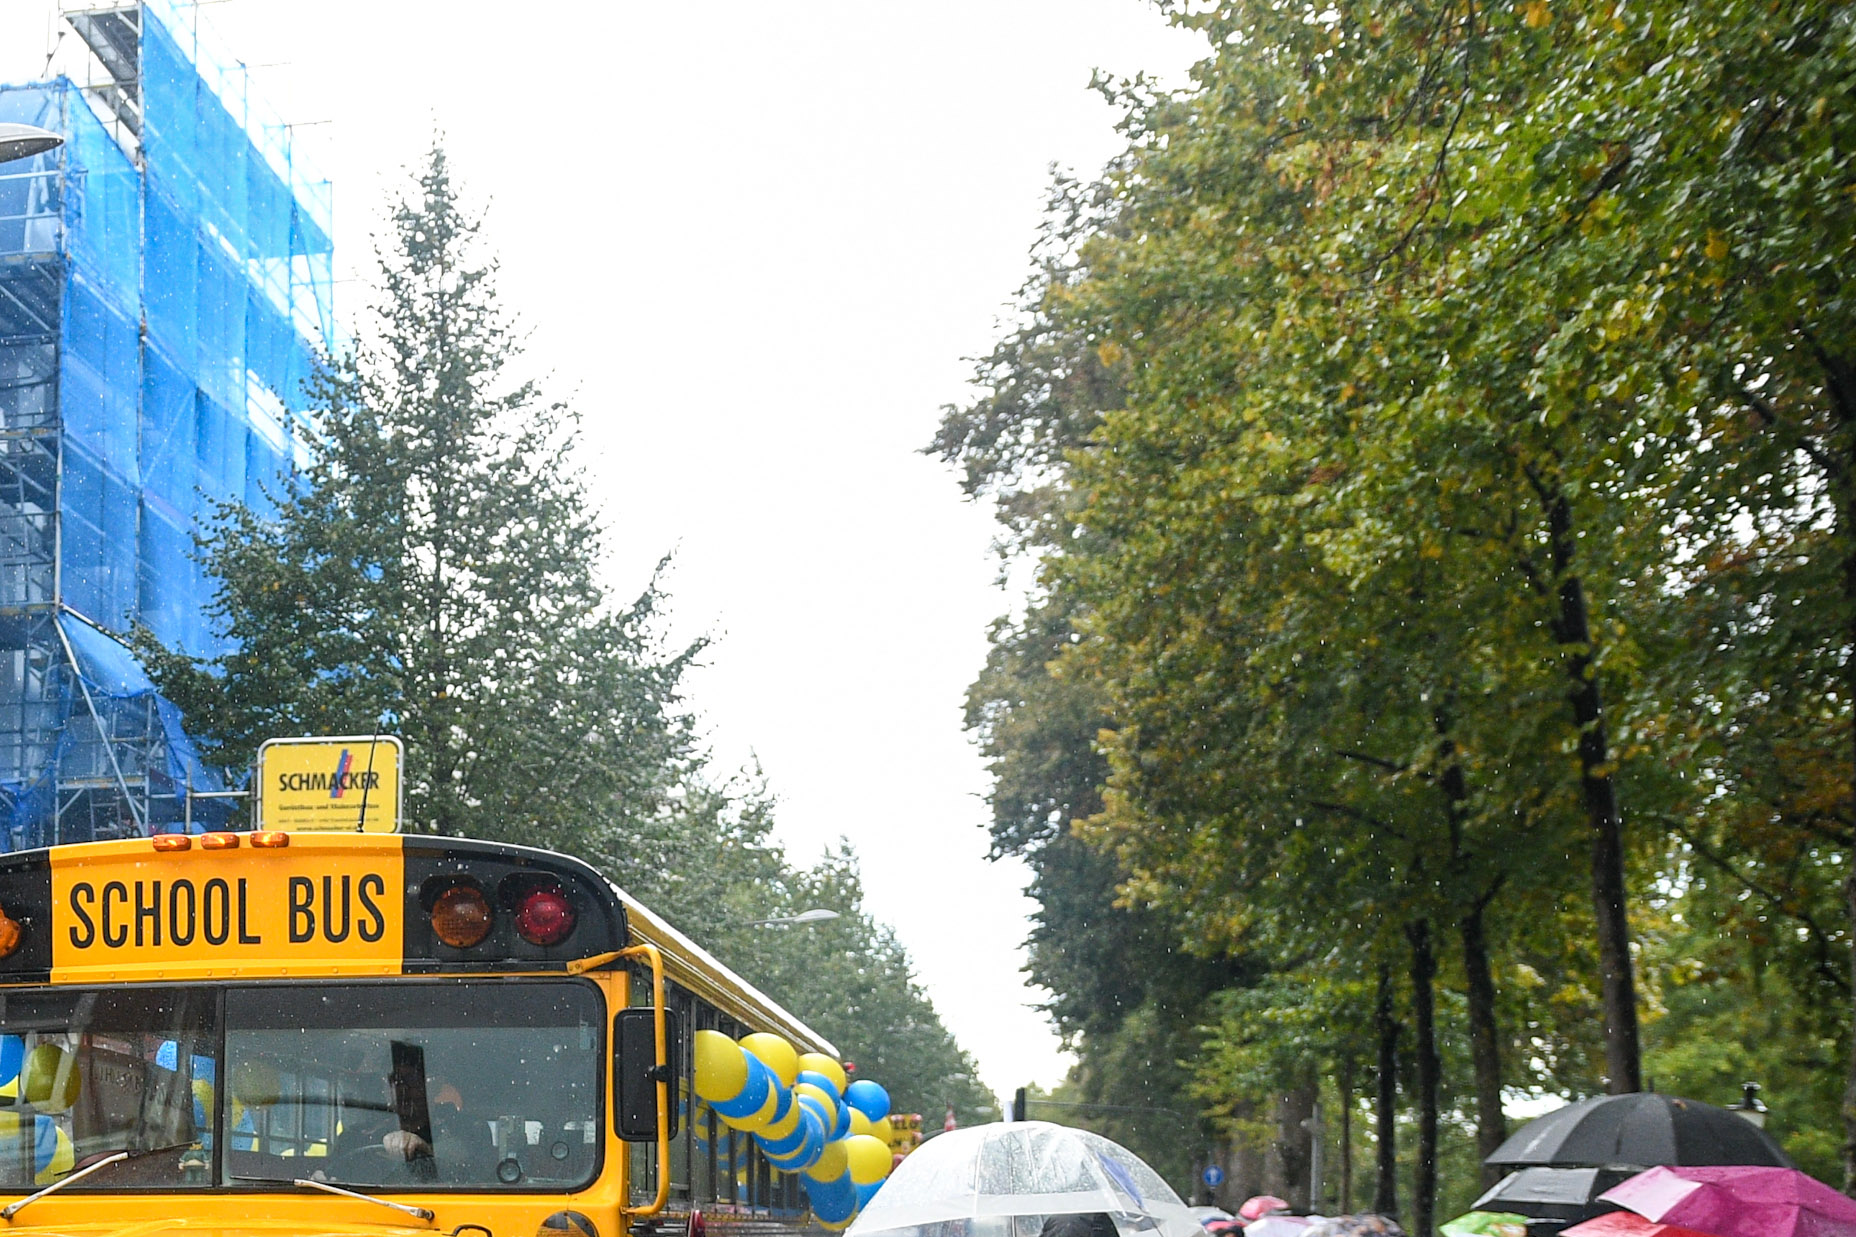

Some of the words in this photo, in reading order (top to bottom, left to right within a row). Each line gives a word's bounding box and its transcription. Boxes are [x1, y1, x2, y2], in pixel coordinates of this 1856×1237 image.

[279, 771, 380, 792] SCHMACKER
[69, 878, 261, 949] SCHOOL
[288, 873, 385, 944] BUS
